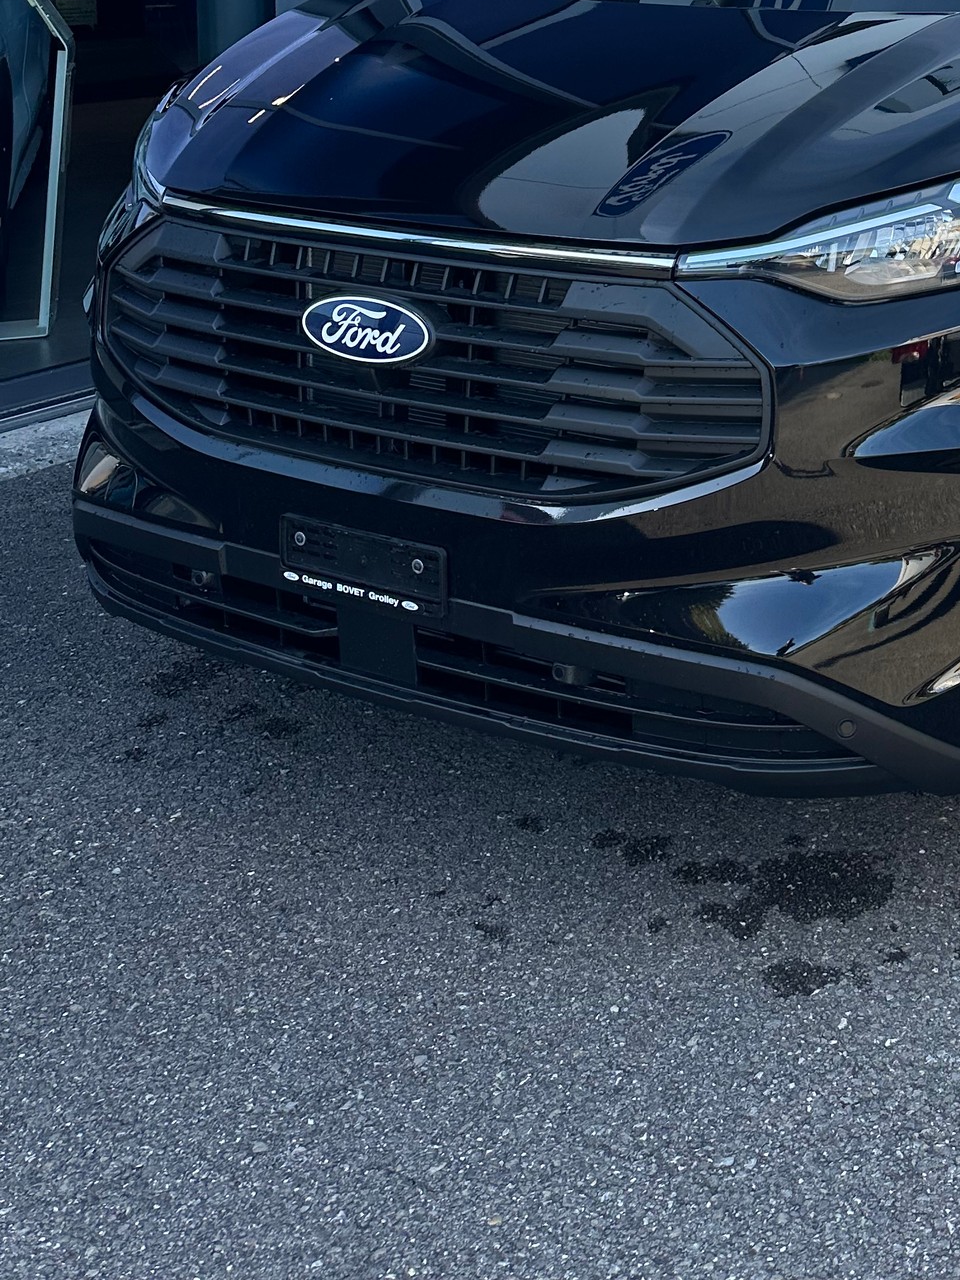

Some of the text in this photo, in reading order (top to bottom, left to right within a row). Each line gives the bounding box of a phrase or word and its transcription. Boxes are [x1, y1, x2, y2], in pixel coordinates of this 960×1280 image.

[321, 303, 406, 355] Ford
[301, 574, 333, 590] Garage
[336, 583, 365, 598] BOVET
[368, 591, 400, 607] Grolley
